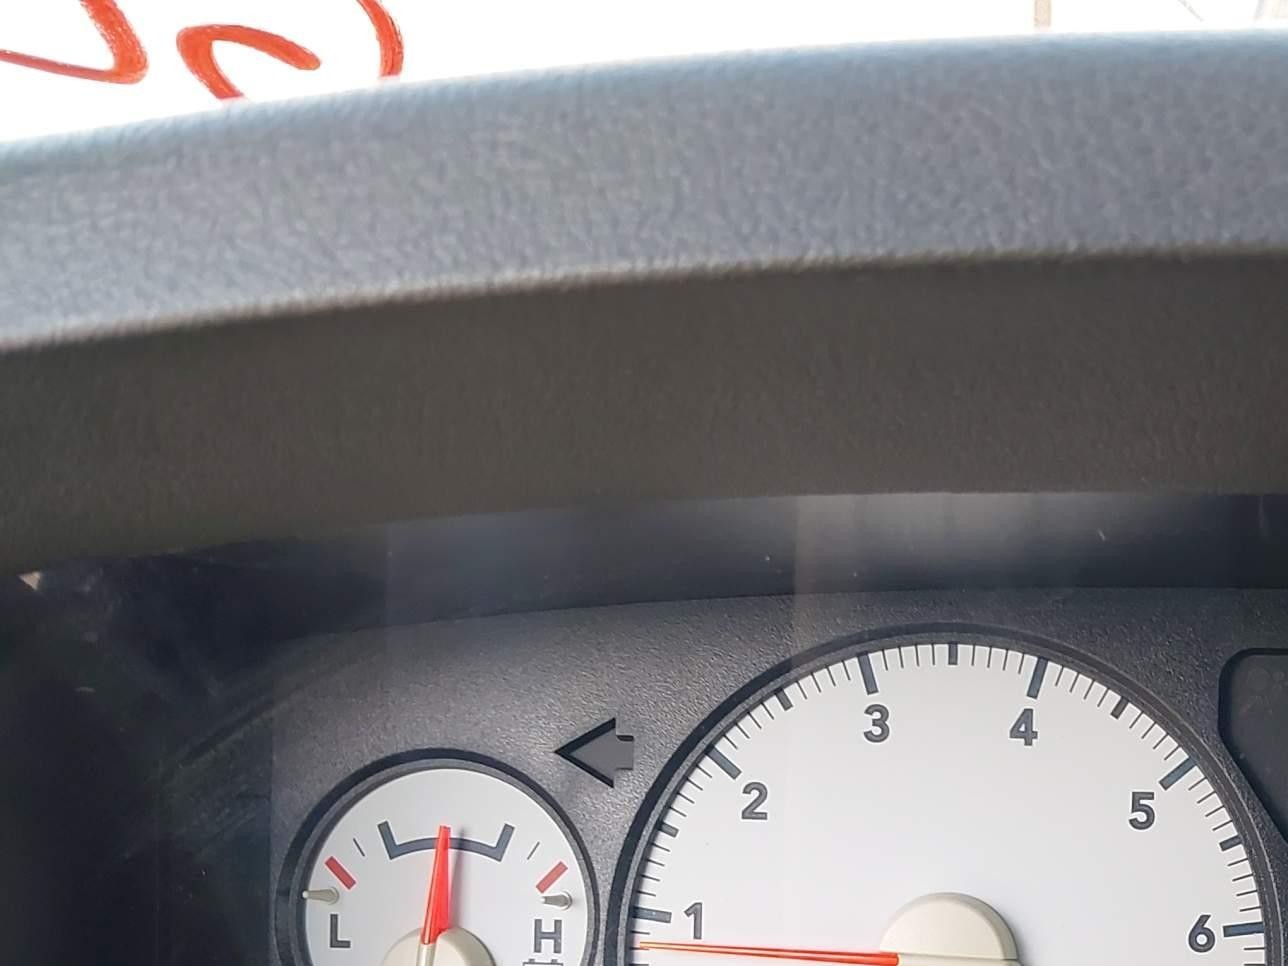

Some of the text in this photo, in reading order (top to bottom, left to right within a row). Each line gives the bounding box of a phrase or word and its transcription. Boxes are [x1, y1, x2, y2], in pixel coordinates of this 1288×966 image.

[863, 703, 890, 744] 3
[1009, 707, 1039, 747] 4
[741, 781, 768, 821] 2
[1128, 791, 1156, 831] 5
[329, 913, 352, 949] L
[533, 918, 563, 955] H
[683, 901, 703, 939] 1
[1187, 914, 1216, 954] 6
